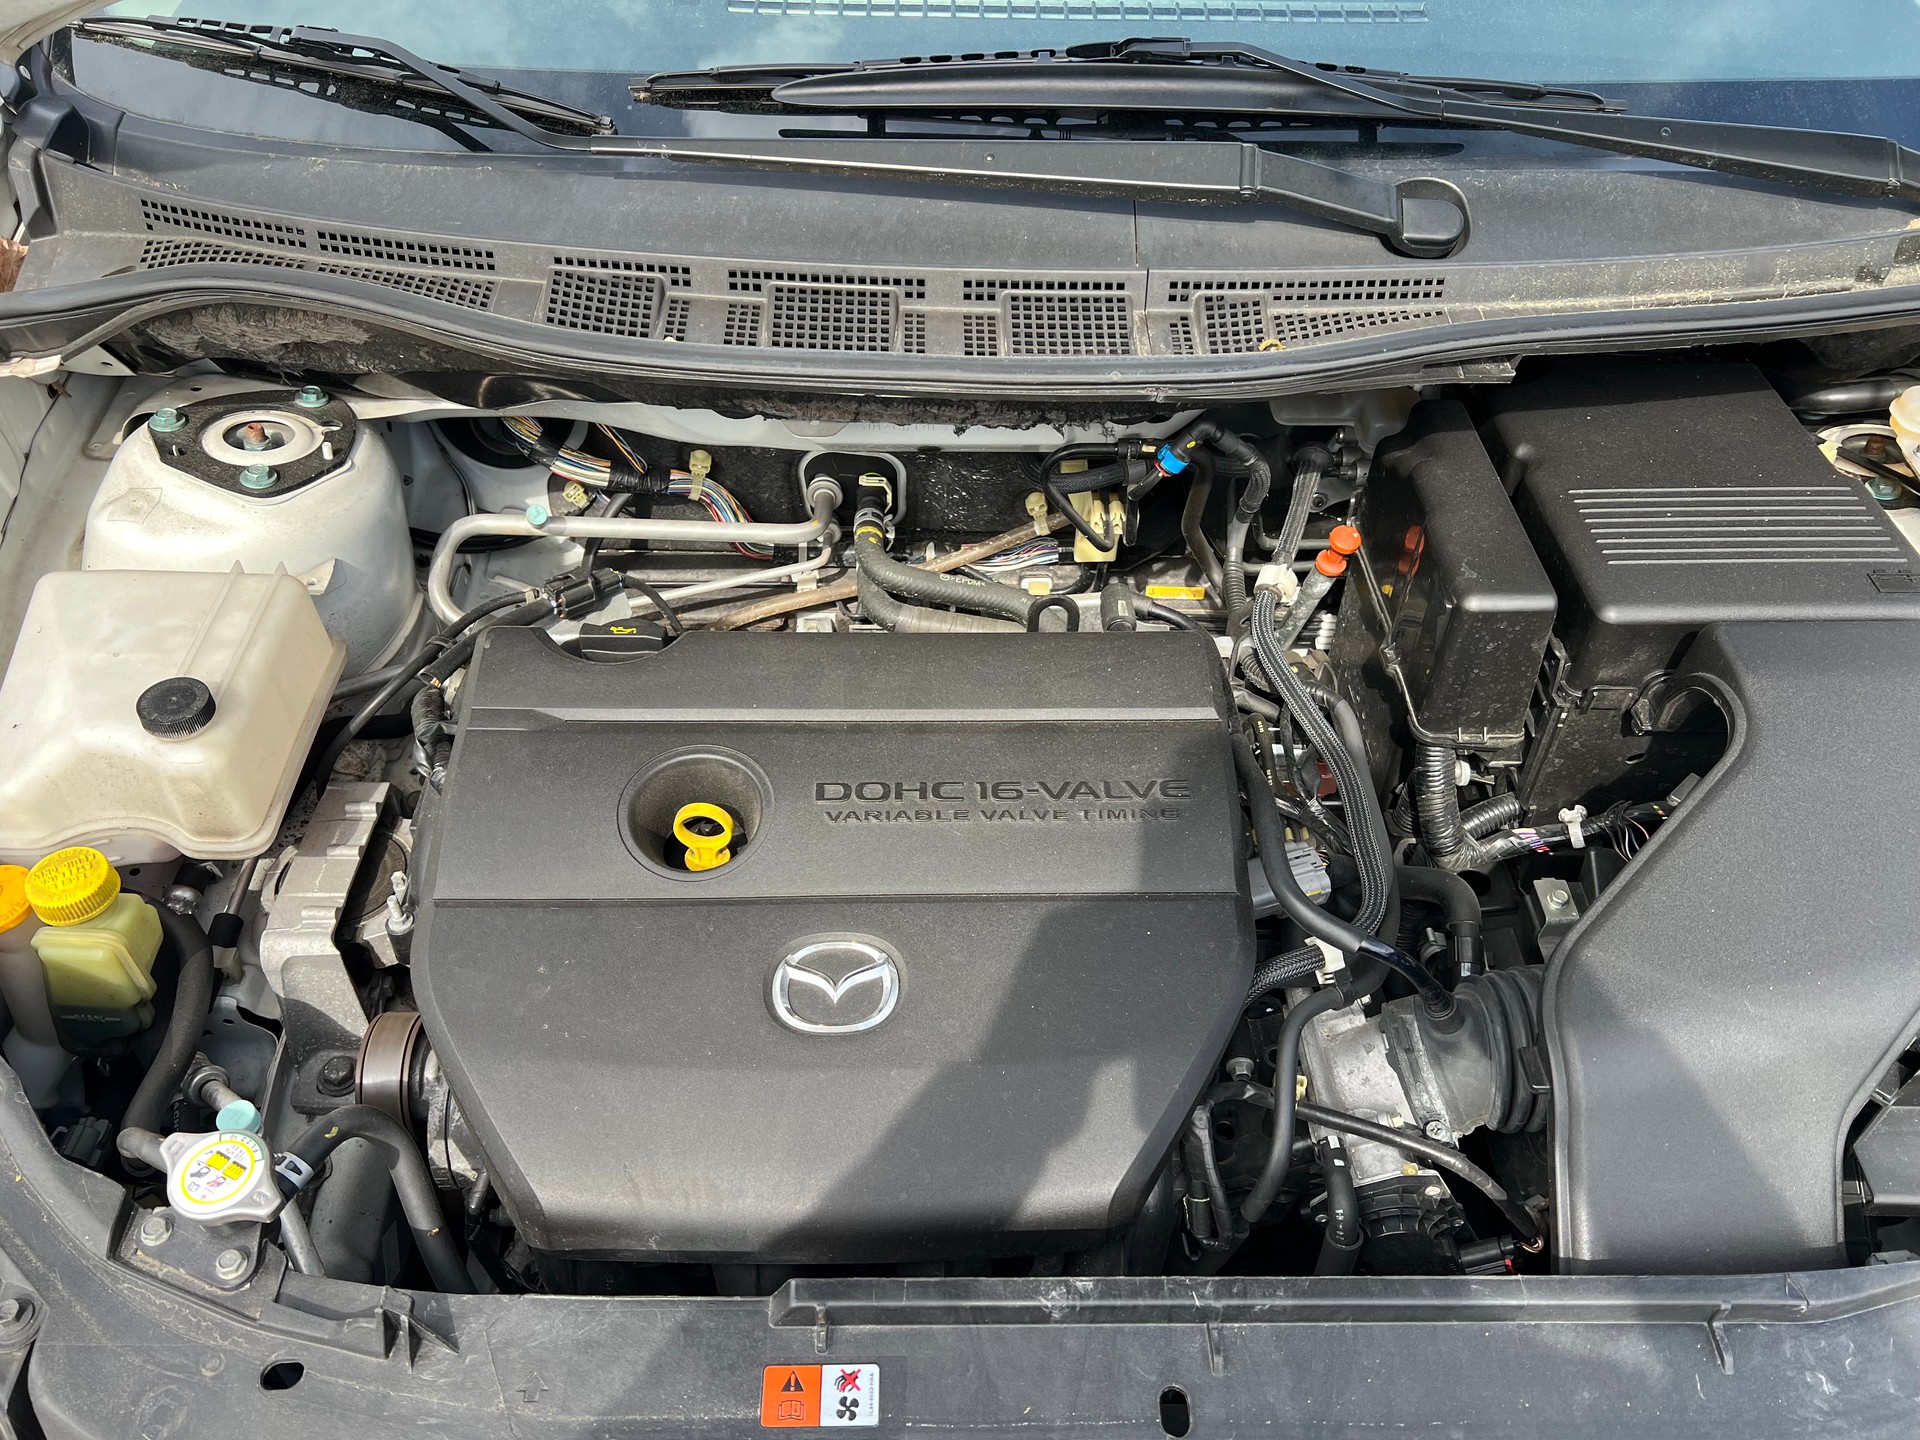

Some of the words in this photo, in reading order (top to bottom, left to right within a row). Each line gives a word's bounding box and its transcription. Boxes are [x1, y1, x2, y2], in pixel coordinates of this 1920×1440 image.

[815, 781, 966, 803] DOHC
[977, 779, 1191, 802] 16-VALVE
[825, 809, 970, 823] VARIABLE
[980, 808, 1068, 822] VALVE
[1081, 807, 1181, 822] TIMING
